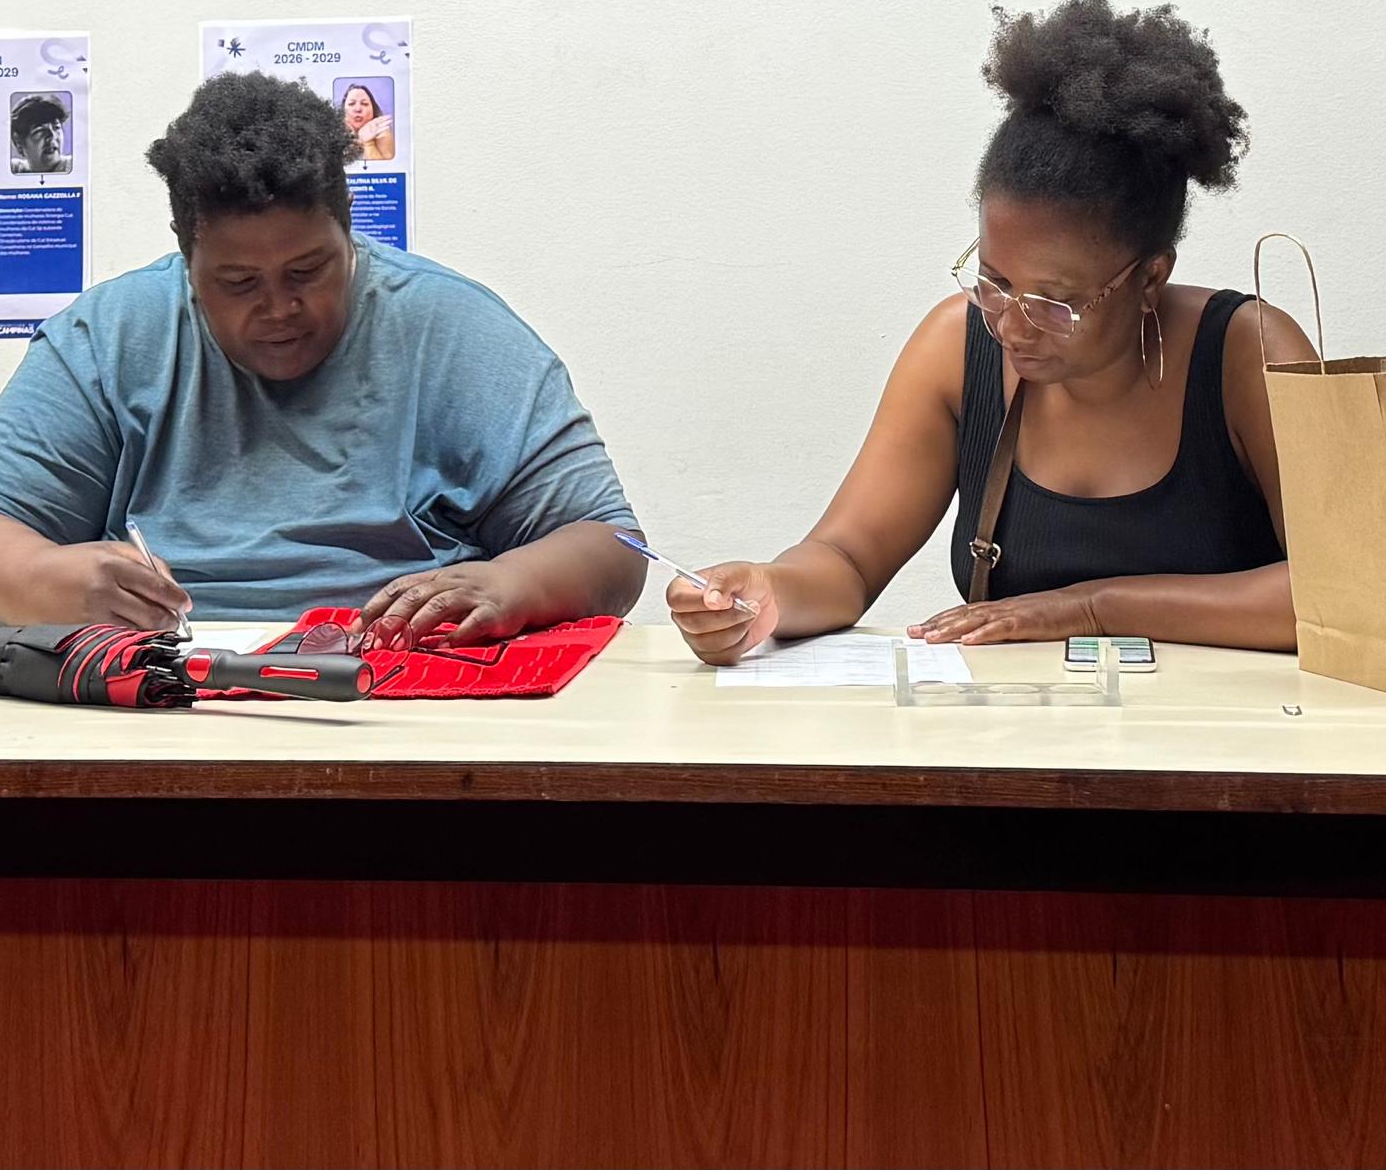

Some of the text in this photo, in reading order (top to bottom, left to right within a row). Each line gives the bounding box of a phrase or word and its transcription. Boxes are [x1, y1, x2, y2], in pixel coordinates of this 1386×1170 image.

[287, 41, 324, 52] CMDM
[274, 54, 302, 64] 2026
[312, 52, 341, 63] 2029
